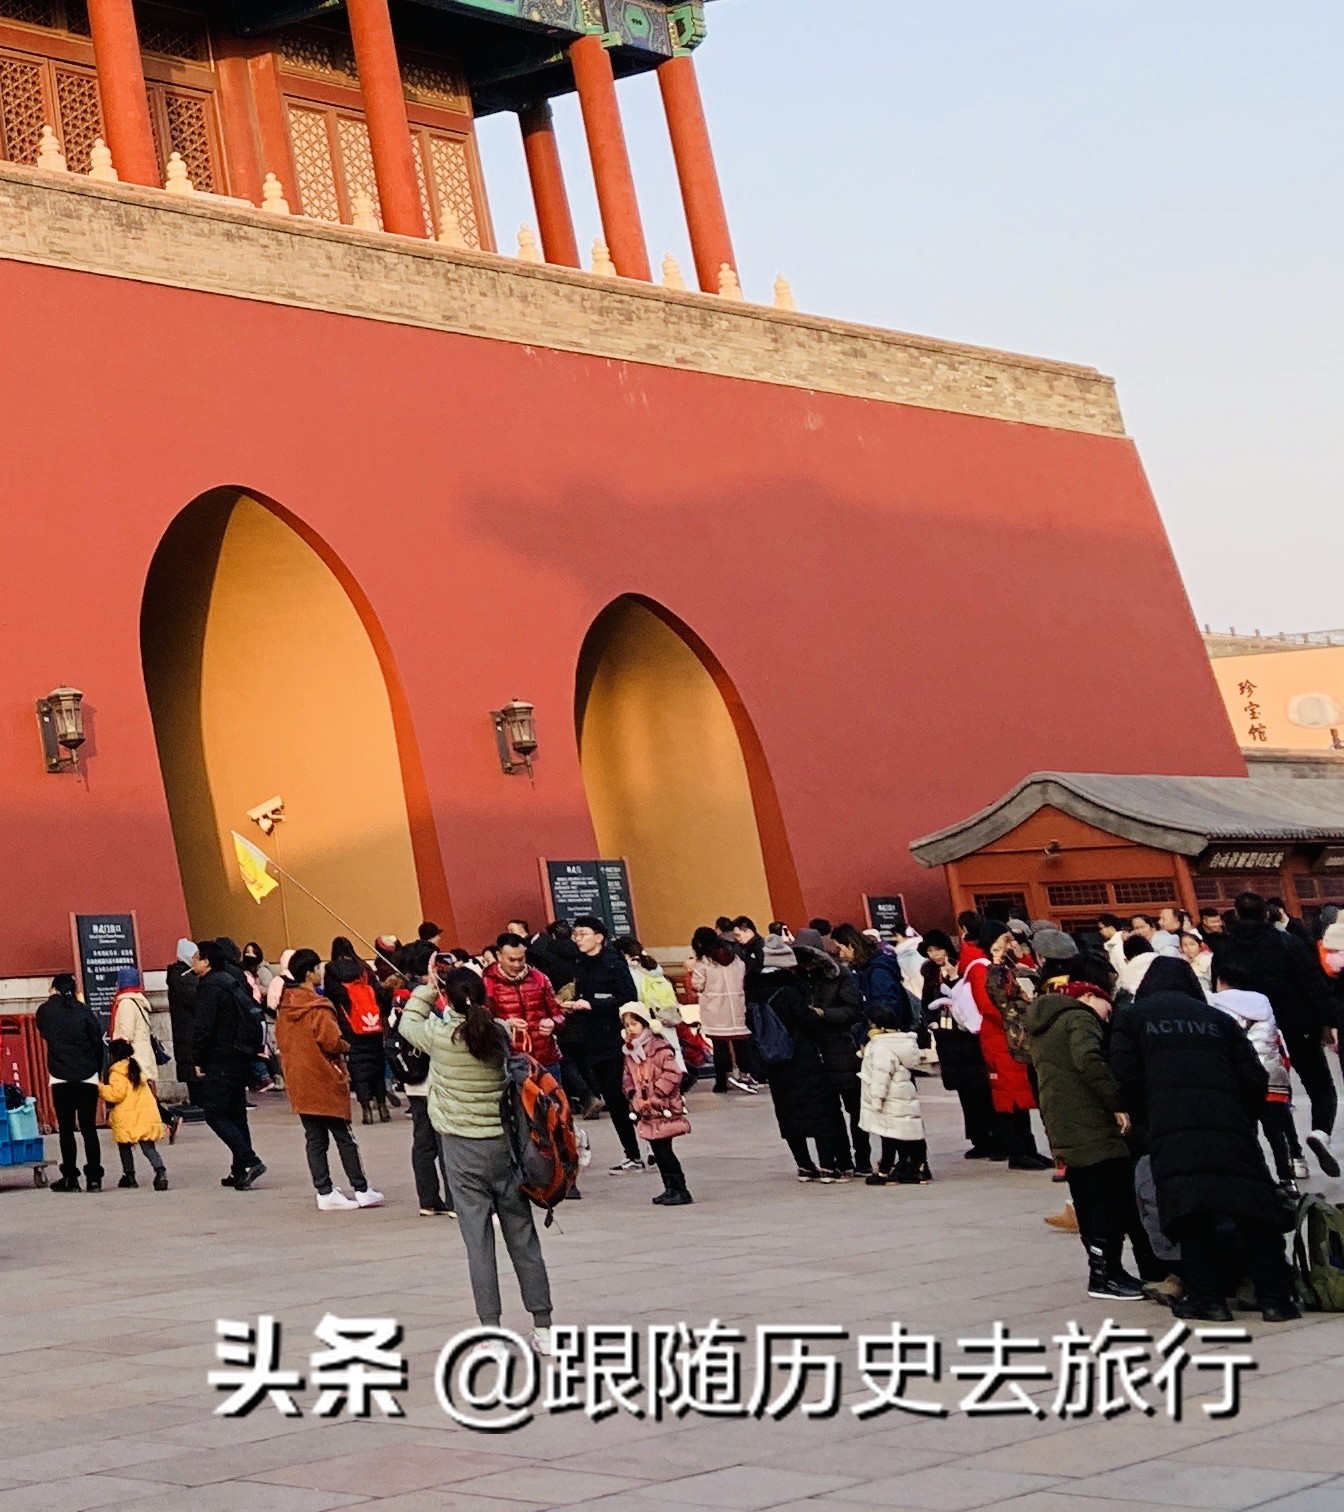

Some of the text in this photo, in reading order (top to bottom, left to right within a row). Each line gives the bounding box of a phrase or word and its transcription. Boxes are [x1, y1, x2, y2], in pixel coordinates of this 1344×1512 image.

[1237, 679, 1268, 742] 珍宝馆
[1144, 1019, 1221, 1037] ACTIVE
